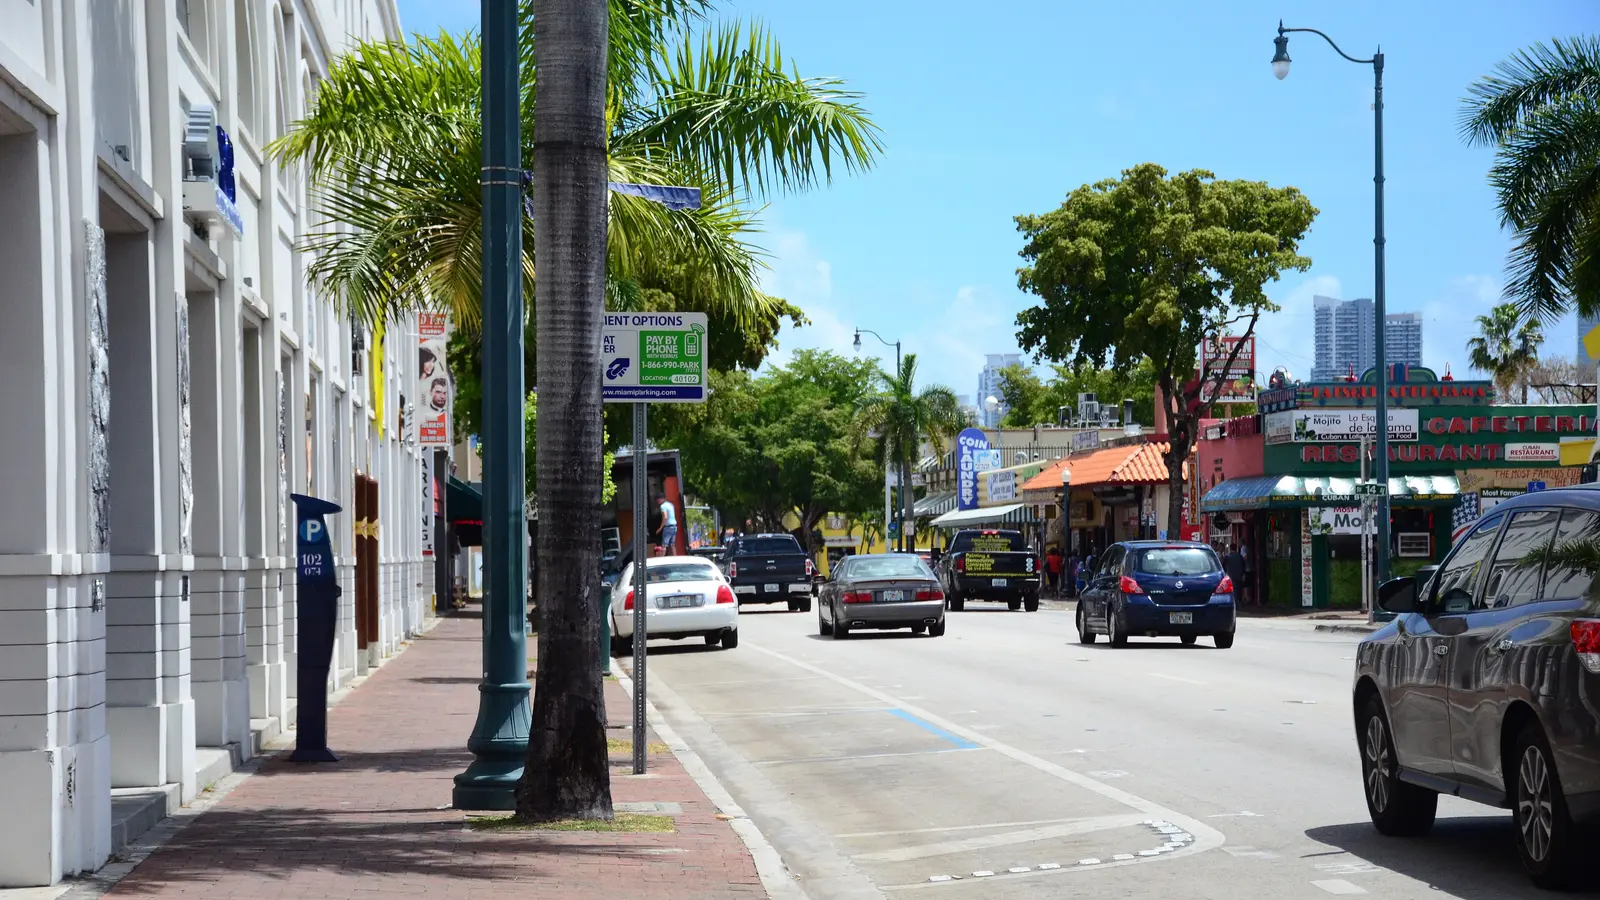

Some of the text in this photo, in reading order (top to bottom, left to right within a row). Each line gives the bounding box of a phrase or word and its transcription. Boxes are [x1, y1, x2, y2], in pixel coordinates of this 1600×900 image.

[632, 315, 683, 326] OPTIONS
[646, 336, 678, 345] PAY BY
[646, 345, 678, 354] PHONE
[1205, 339, 1252, 353] CLN
[642, 361, 700, 369] 1-866-990-PARK
[674, 375, 698, 383] 40102
[1333, 386, 1399, 399] ESQUIA
[1313, 418, 1341, 426] Mojito
[1348, 414, 1394, 423] La Esqa
[1349, 422, 1412, 432] de la ama
[960, 436, 988, 450] COIN
[1303, 444, 1499, 462] RESURANT
[960, 446, 974, 505] LAUNDRY
[1495, 468, 1582, 479] THE MOST FAMOUS CUB
[1554, 478, 1581, 487] THE BE
[1365, 485, 1377, 495] 14
[306, 520, 321, 541] P
[301, 553, 322, 565] 102
[304, 567, 321, 576] 074
